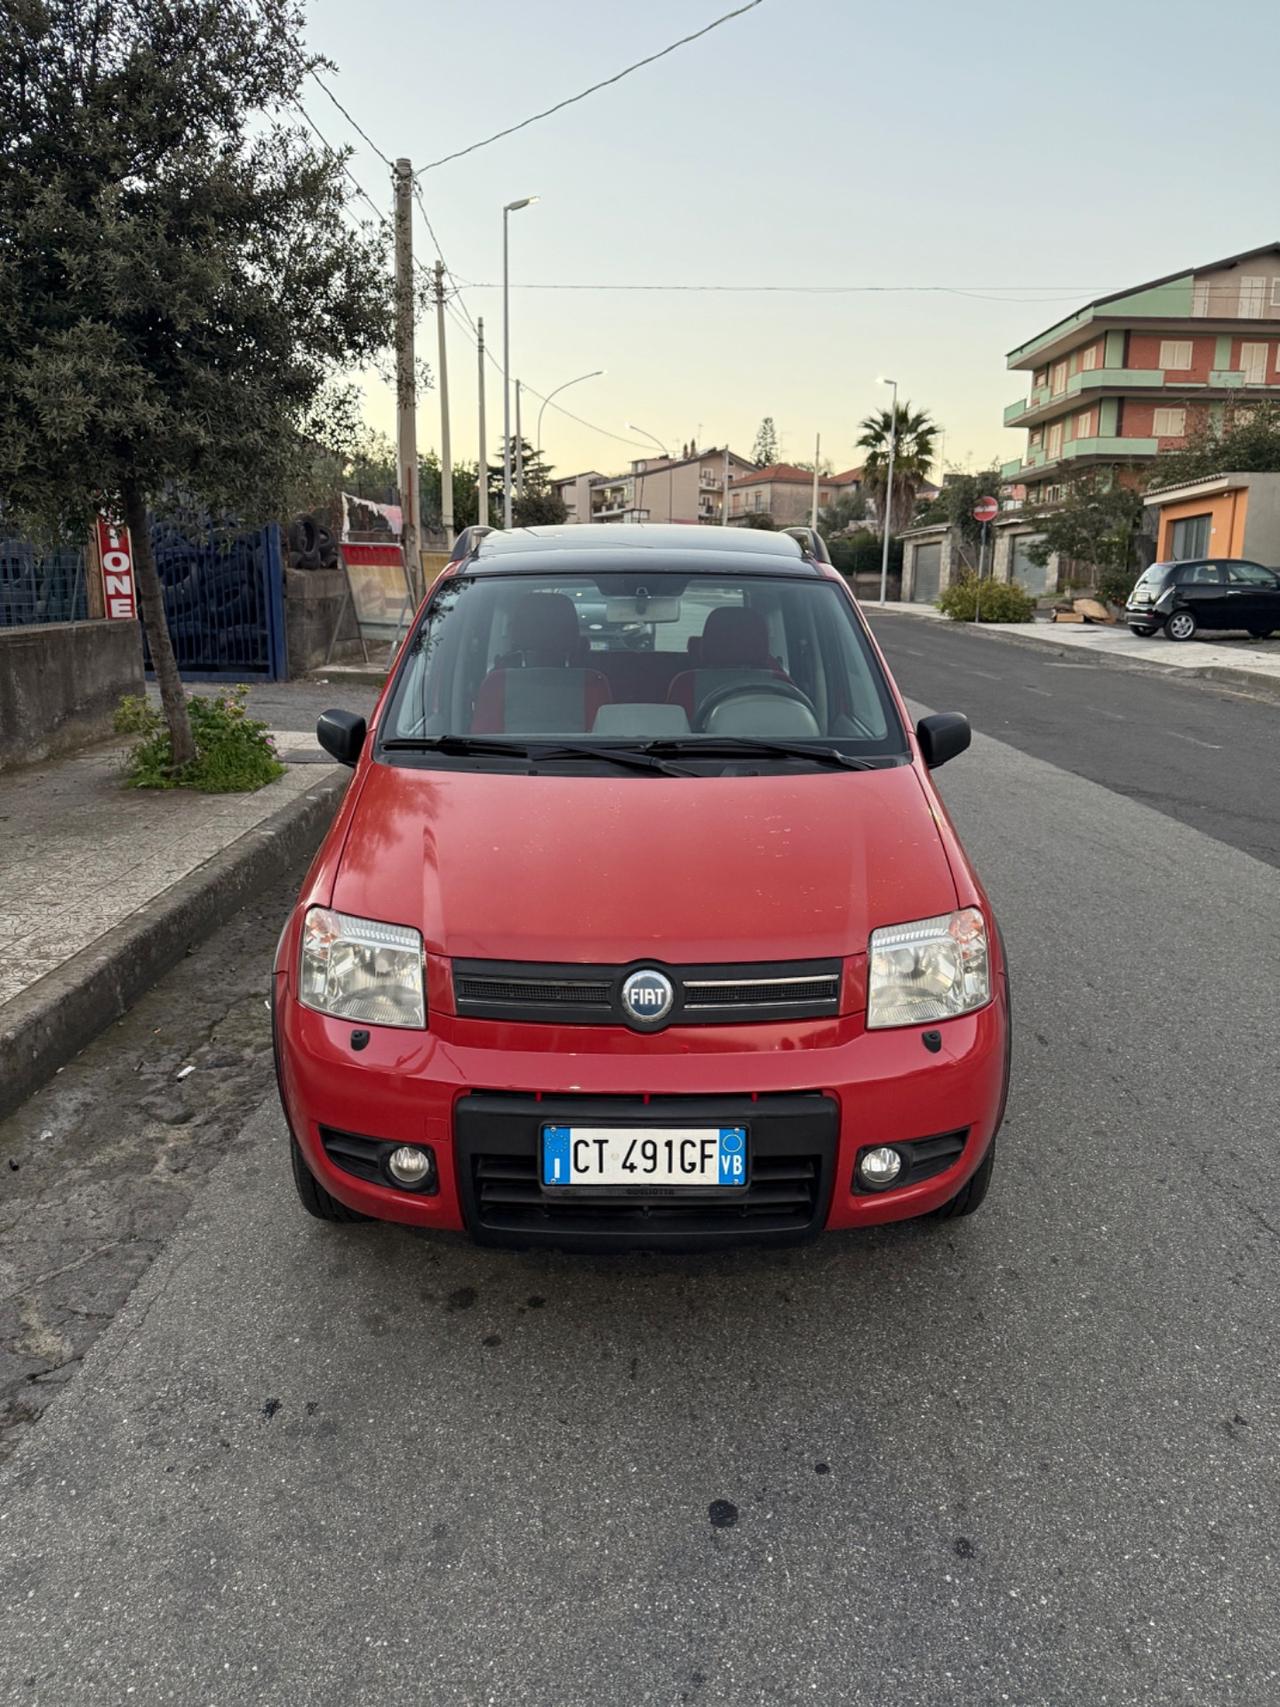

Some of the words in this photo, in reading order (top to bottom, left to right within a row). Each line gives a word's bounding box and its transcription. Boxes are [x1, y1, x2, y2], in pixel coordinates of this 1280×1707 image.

[631, 988, 664, 1005] FIAT
[573, 1139, 609, 1173] CT
[621, 1139, 717, 1173] 491GF
[721, 1154, 743, 1175] VB
[554, 1158, 560, 1178] I
